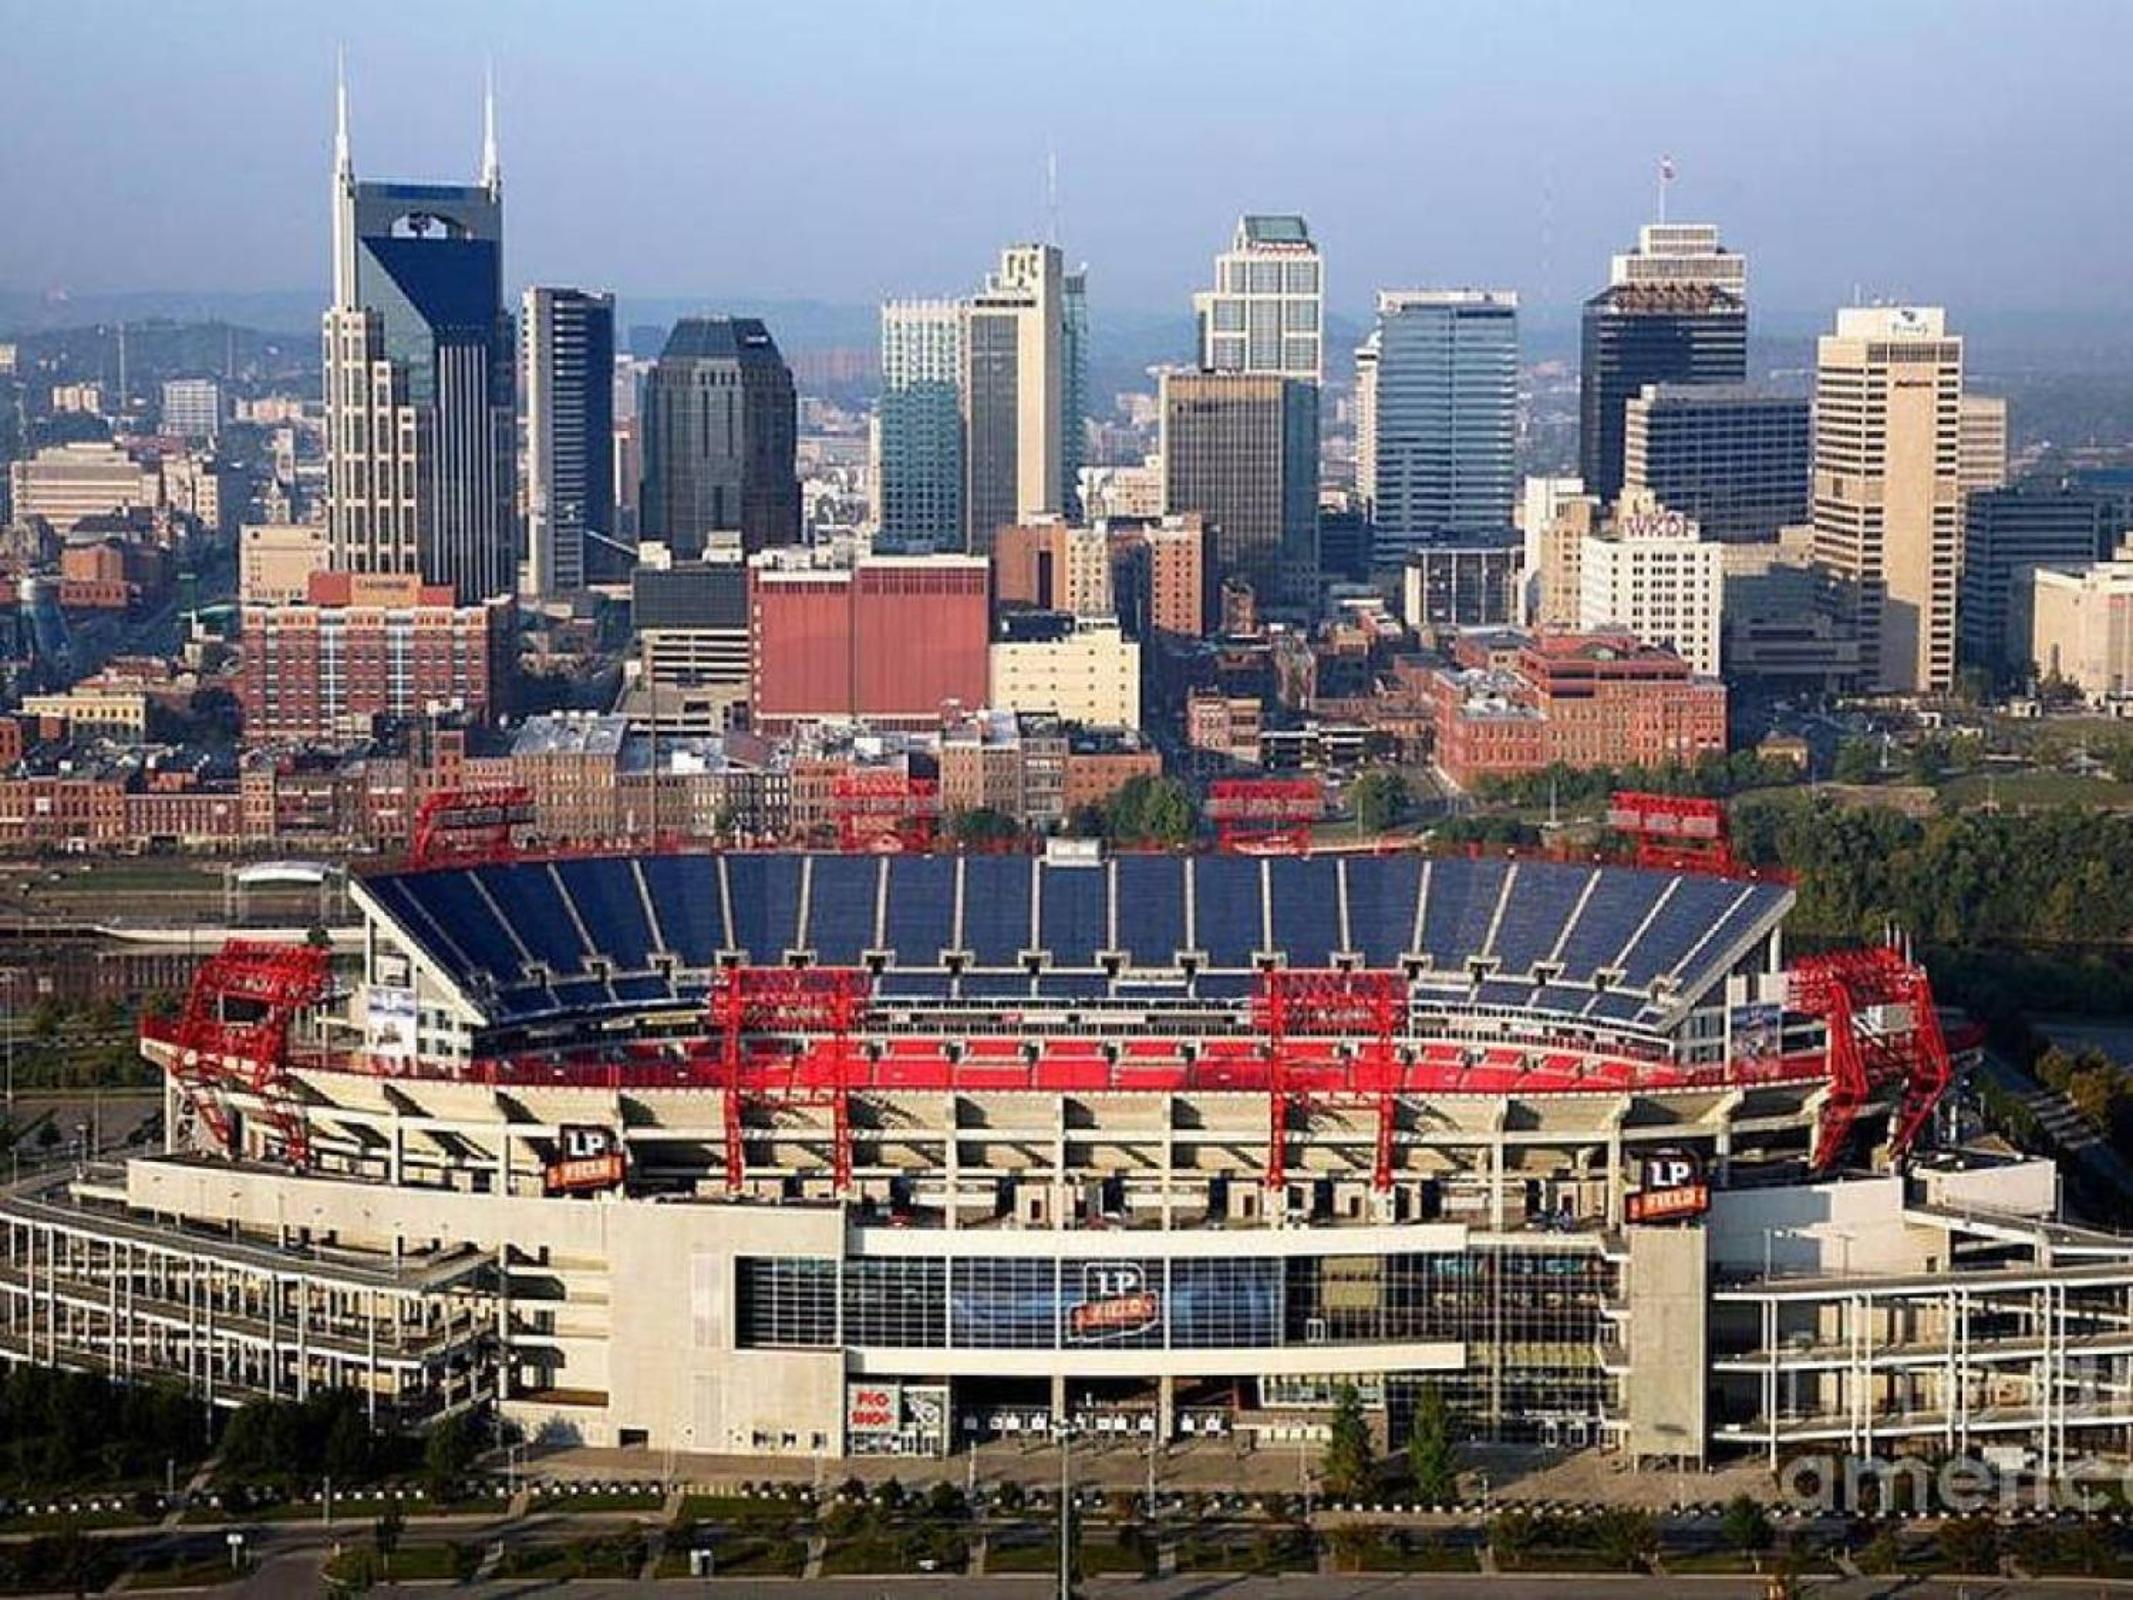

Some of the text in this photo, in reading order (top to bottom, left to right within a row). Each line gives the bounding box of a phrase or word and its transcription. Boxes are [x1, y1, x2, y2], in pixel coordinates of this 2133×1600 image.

[568, 1130, 605, 1156] LP
[1649, 1160, 1691, 1186] LP
[1095, 1271, 1138, 1295] LP
